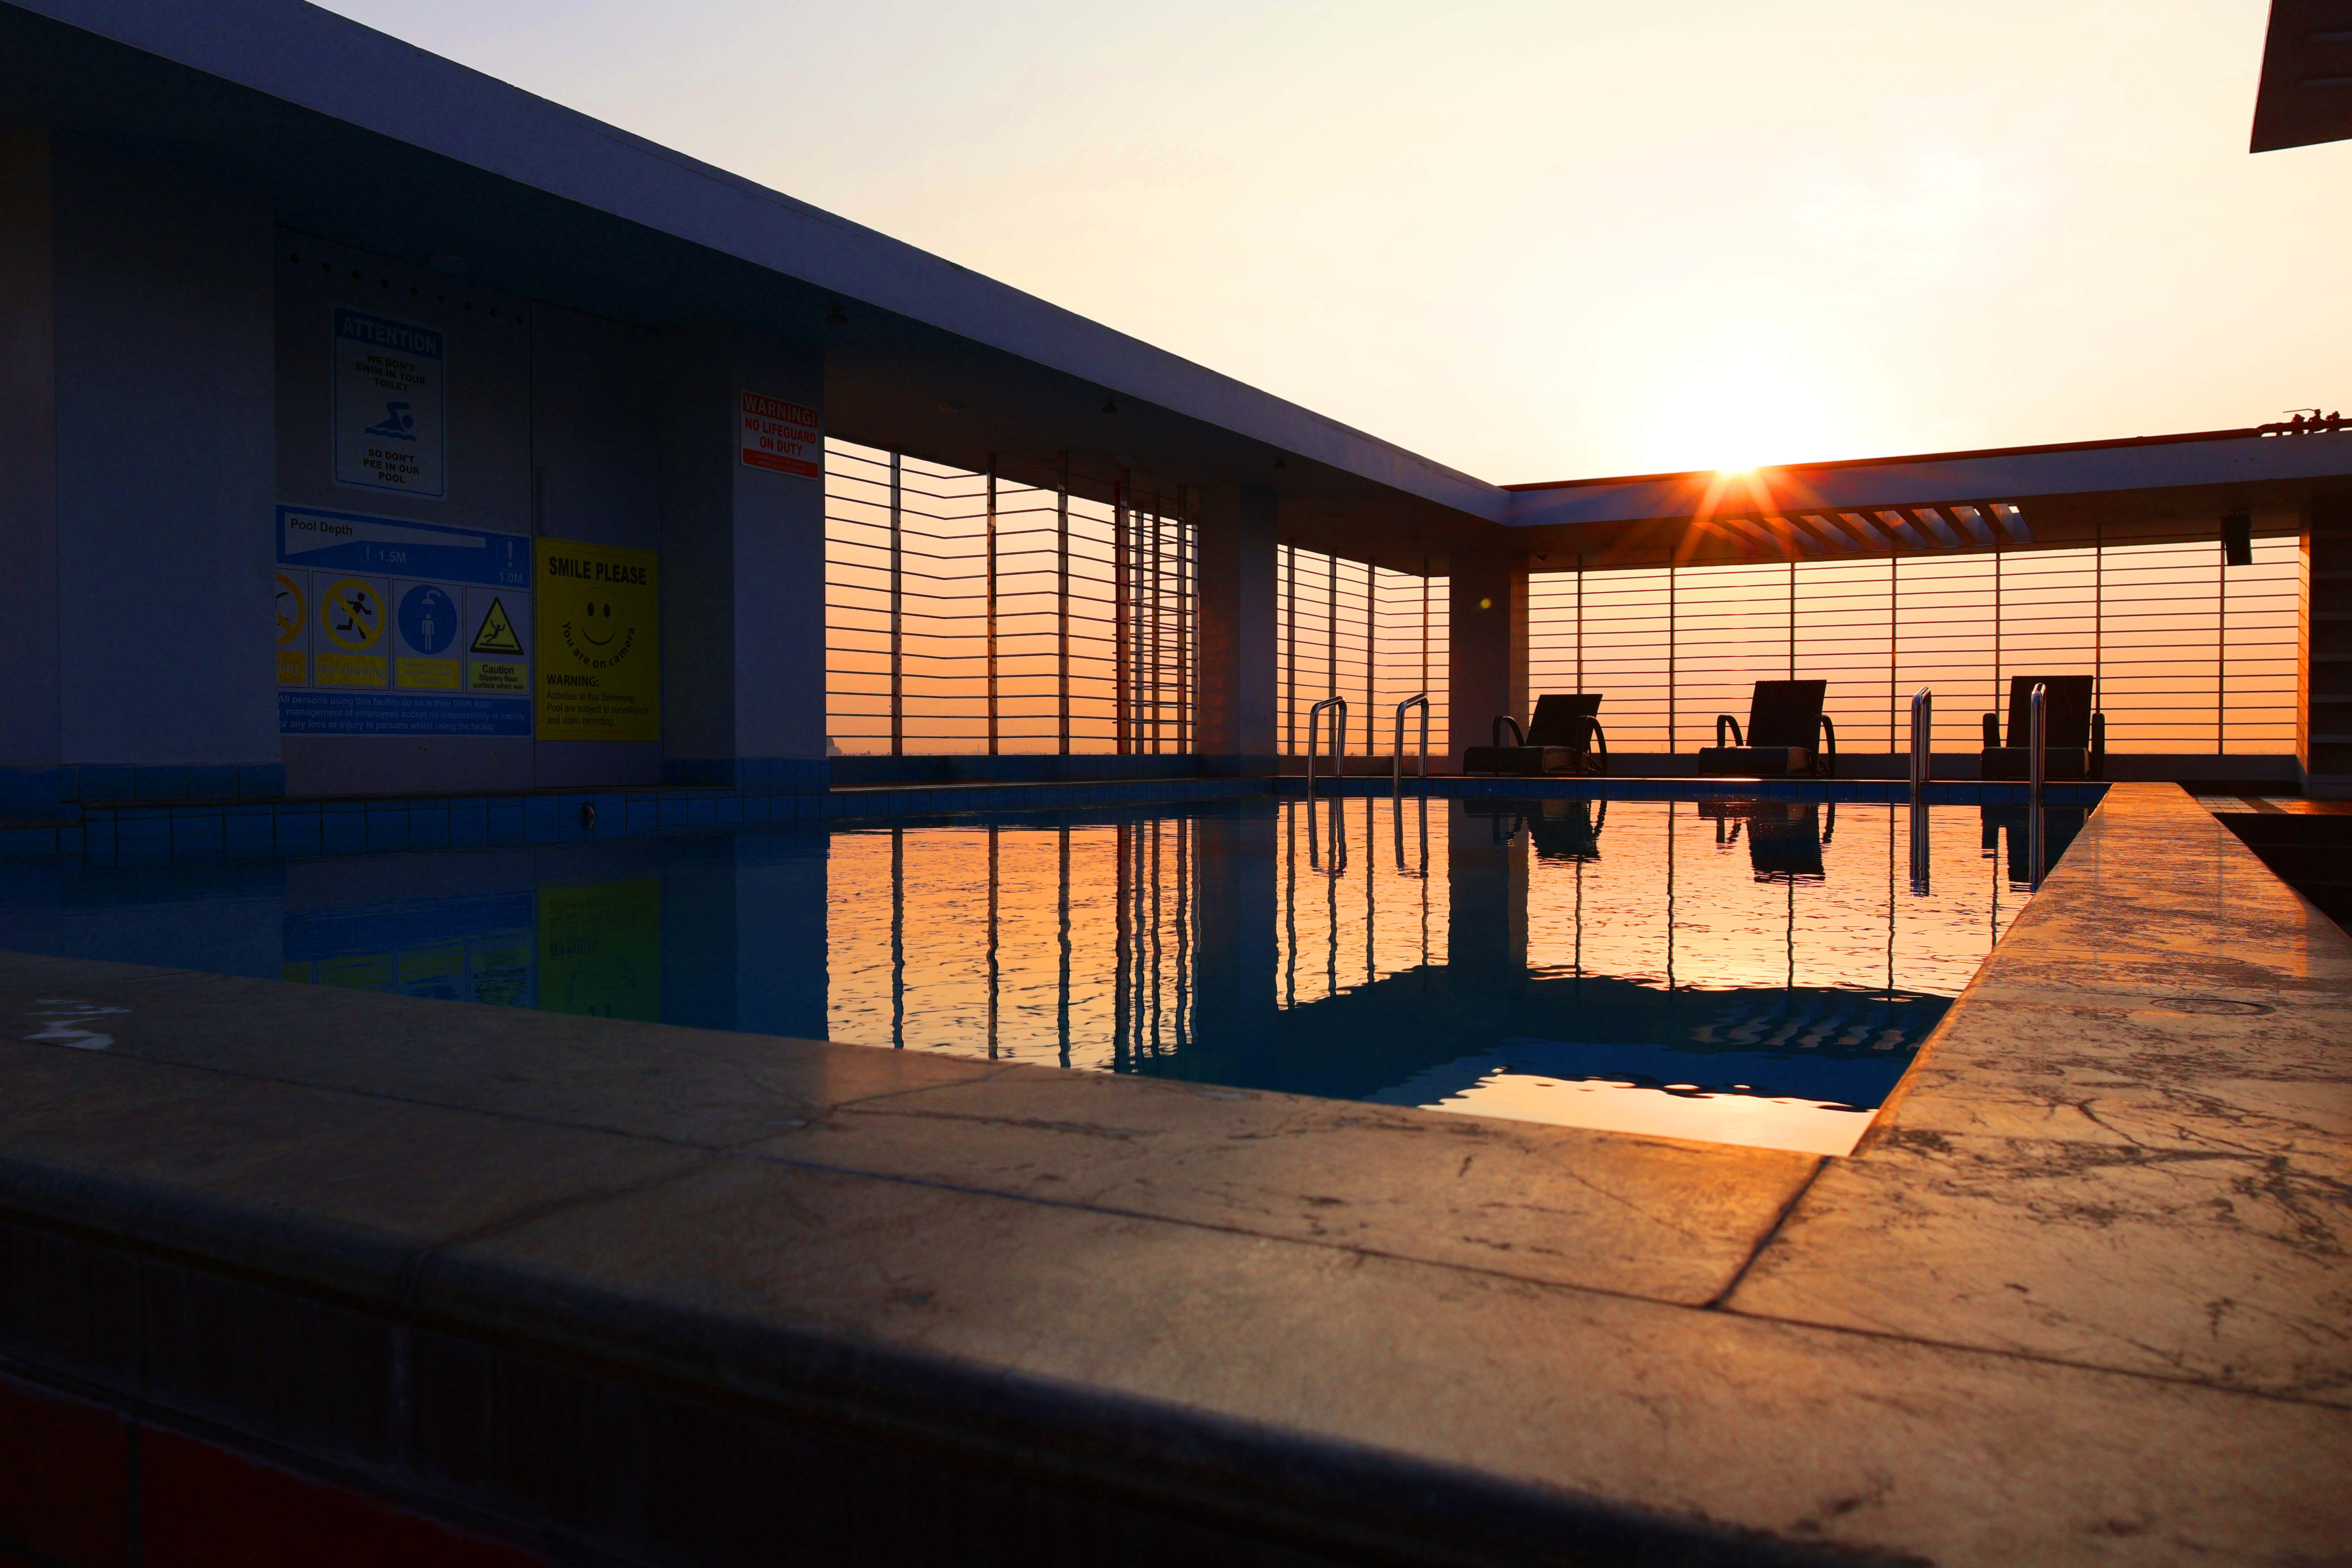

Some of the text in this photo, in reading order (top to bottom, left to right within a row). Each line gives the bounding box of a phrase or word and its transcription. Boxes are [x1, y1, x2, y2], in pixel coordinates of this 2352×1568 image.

[342, 315, 437, 354] ATTENTION
[367, 354, 414, 372] WE DON'T
[355, 363, 426, 385] SWIM IN YOUR
[374, 377, 408, 392] TOILET
[745, 394, 816, 426] WARNING!
[745, 417, 816, 444] NO LIFEGUARD
[759, 436, 803, 456] ON DUTY
[368, 448, 414, 463] SO DON'T
[363, 458, 420, 475] PEE IN OUR
[379, 472, 405, 483] POOL
[291, 518, 353, 536] Pool Depth
[378, 551, 407, 564] 1.5M
[498, 571, 523, 584] 1.0M
[549, 556, 646, 585] SMILE PLEASE
[561, 621, 635, 669] You are on camera
[318, 662, 384, 679] No running
[482, 664, 514, 674] Caution
[479, 674, 505, 682] Slippery
[546, 674, 599, 687] WARNING:
[279, 695, 290, 703] All
[292, 697, 328, 705] persons
[330, 696, 353, 707] using
[356, 697, 371, 705] this
[373, 697, 399, 708] facility
[453, 699, 472, 708] OWN
[474, 700, 492, 709] RISK
[546, 690, 577, 701] Activities
[588, 692, 599, 701] this
[601, 693, 634, 704] Swimming
[286, 709, 345, 718] management
[345, 708, 353, 717] of
[355, 710, 399, 719] employees
[401, 711, 427, 720] accept
[440, 711, 490, 721] responsibility
[500, 712, 526, 722] liability
[547, 703, 563, 713] Pool
[577, 705, 602, 715] subject
[611, 706, 649, 715] surveillance
[289, 721, 306, 730] any
[308, 719, 327, 728] loss
[340, 720, 364, 731] injury
[376, 722, 408, 731] persons
[410, 721, 433, 730] whilst
[435, 721, 456, 732] using
[457, 722, 469, 731] the
[470, 722, 495, 733] facility
[547, 716, 560, 724] and
[562, 716, 581, 725] video
